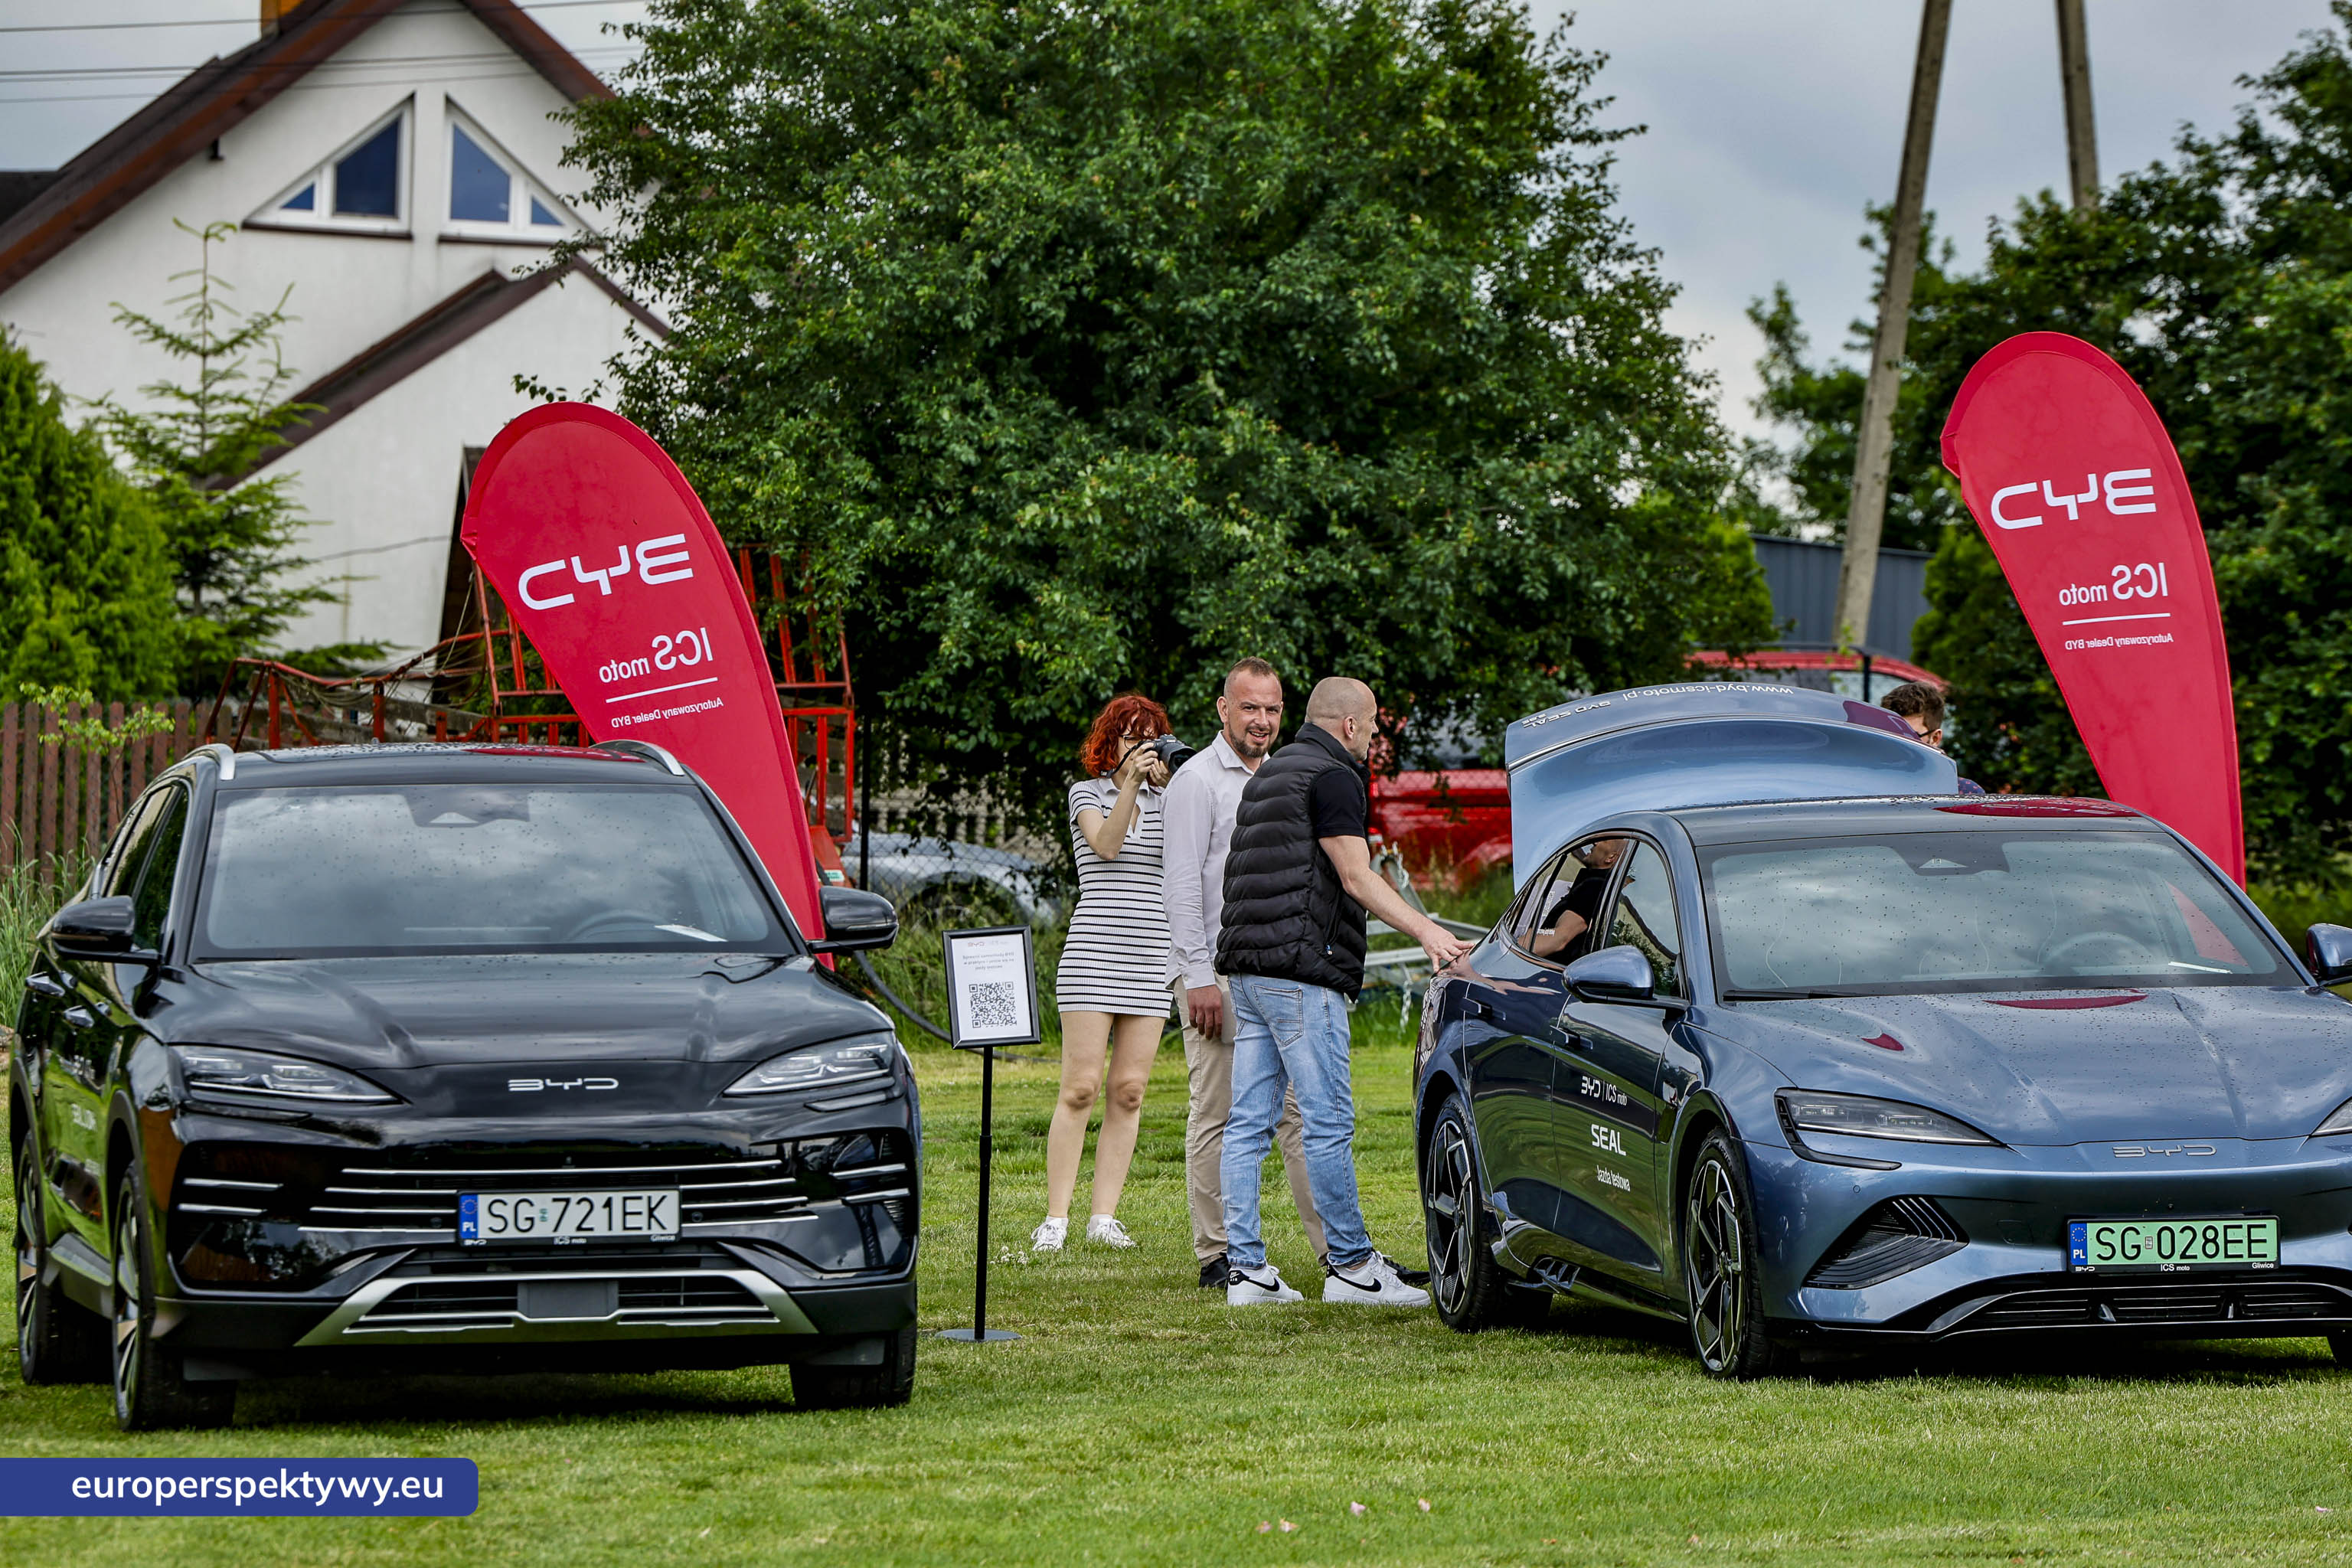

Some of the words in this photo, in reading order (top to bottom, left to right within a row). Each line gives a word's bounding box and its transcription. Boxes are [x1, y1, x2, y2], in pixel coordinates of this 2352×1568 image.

[1622, 683, 1794, 701] www.byd-icsmoto.pl
[508, 1078, 619, 1091] BYD
[1581, 1076, 1601, 1098] BYD
[1606, 1083, 1616, 1103] ICS
[1617, 1093, 1628, 1106] moto
[1591, 1124, 1626, 1156] SEAL
[2112, 1144, 2217, 1158] BYD
[1597, 1165, 1612, 1184] Jazda
[1610, 1170, 1630, 1192] testowa
[488, 1198, 535, 1233] SG
[551, 1195, 668, 1233] 721EK
[462, 1222, 476, 1232] PL
[2096, 1226, 2141, 1260] SG
[2156, 1223, 2268, 1260] 028EE
[2073, 1250, 2086, 1259] PL
[2161, 1263, 2174, 1272] ICS
